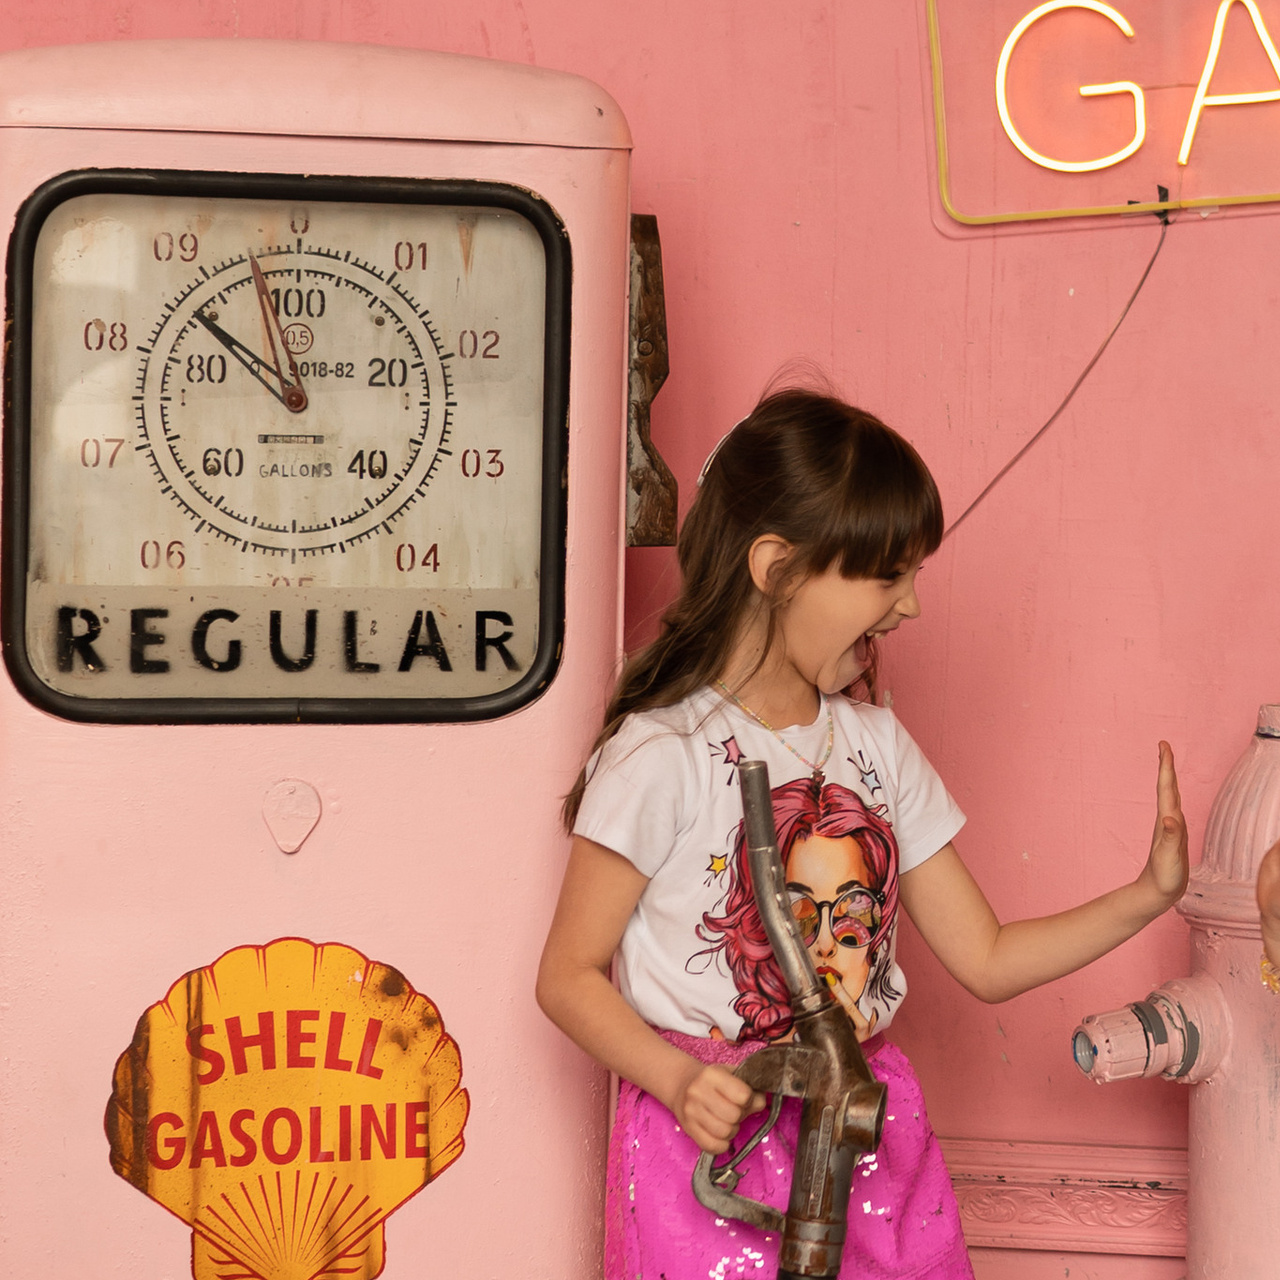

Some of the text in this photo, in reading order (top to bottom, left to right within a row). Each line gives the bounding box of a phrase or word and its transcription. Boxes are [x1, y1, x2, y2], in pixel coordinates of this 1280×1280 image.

[154, 232, 199, 262] 09
[394, 241, 429, 272] 01
[271, 288, 325, 318] 100
[83, 322, 128, 351] 08
[458, 329, 500, 359] 02
[186, 354, 227, 384] 80
[367, 357, 408, 388] 20
[80, 437, 126, 469] 07
[202, 448, 244, 478] 60
[347, 449, 388, 480] 40
[461, 448, 505, 480] 03
[259, 463, 333, 479] GALLONS
[140, 540, 186, 570] 06
[395, 542, 441, 573] 04
[54, 605, 522, 675] REGULAR
[185, 1009, 384, 1086] SHELL
[146, 1101, 431, 1171] GASOLINE
